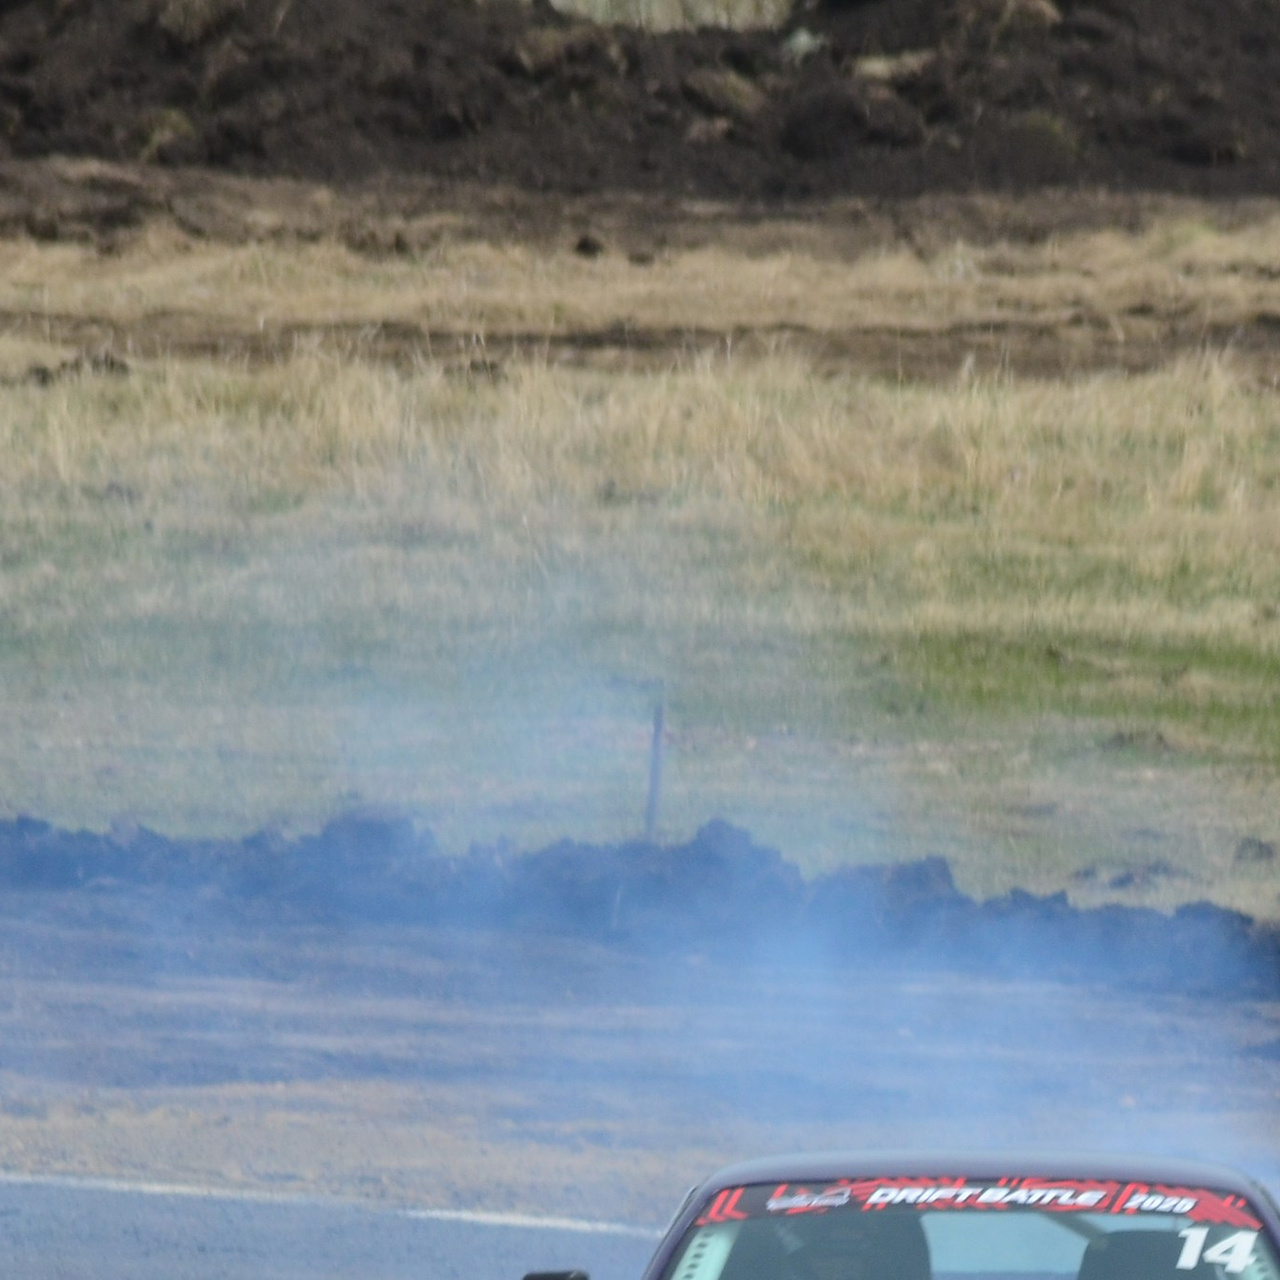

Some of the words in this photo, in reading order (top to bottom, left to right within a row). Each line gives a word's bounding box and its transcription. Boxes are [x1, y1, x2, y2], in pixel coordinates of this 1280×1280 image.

[867, 1187, 983, 1204] DRIFT
[976, 1187, 1108, 1207] BATTLE
[1177, 1226, 1259, 1274] 14
